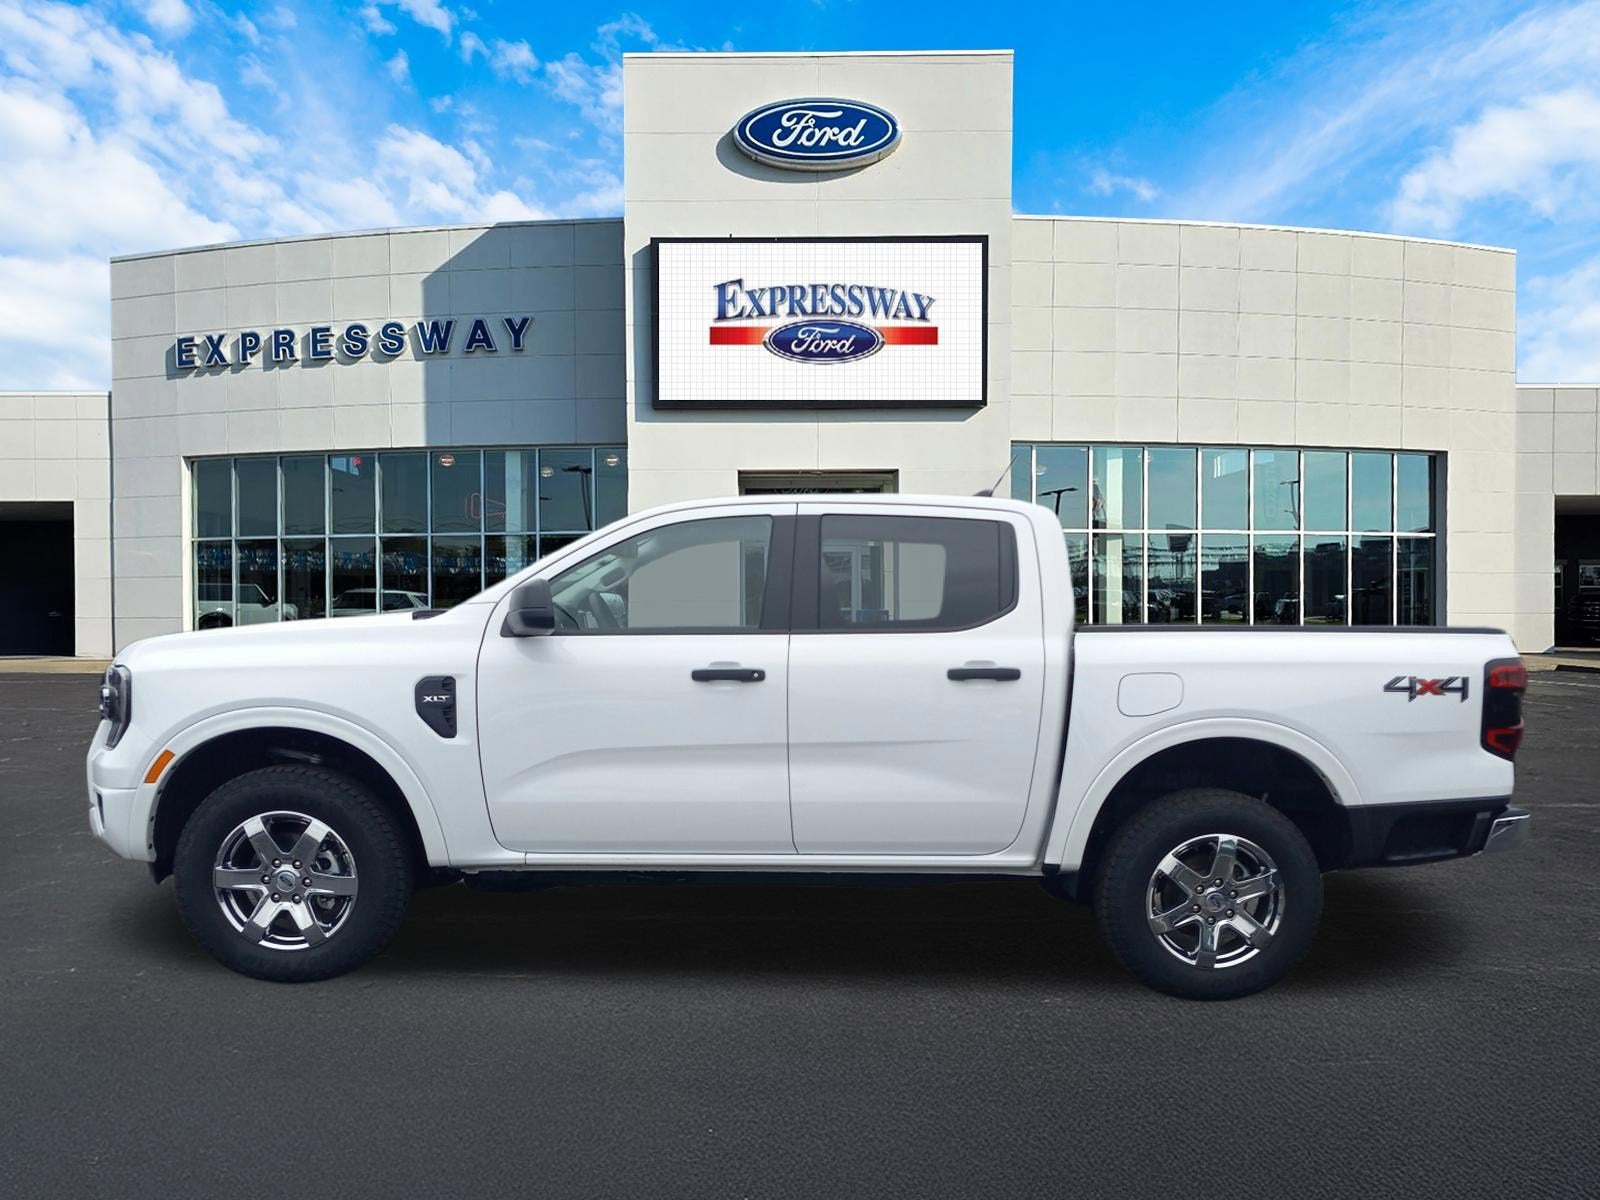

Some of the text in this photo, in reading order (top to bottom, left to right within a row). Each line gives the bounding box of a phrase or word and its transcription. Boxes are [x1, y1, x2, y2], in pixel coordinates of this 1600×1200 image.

[772, 109, 867, 147] Ford
[713, 278, 936, 323] EXPRESSWAY
[174, 316, 532, 369] EXPRESSWAY
[791, 327, 855, 353] Ford
